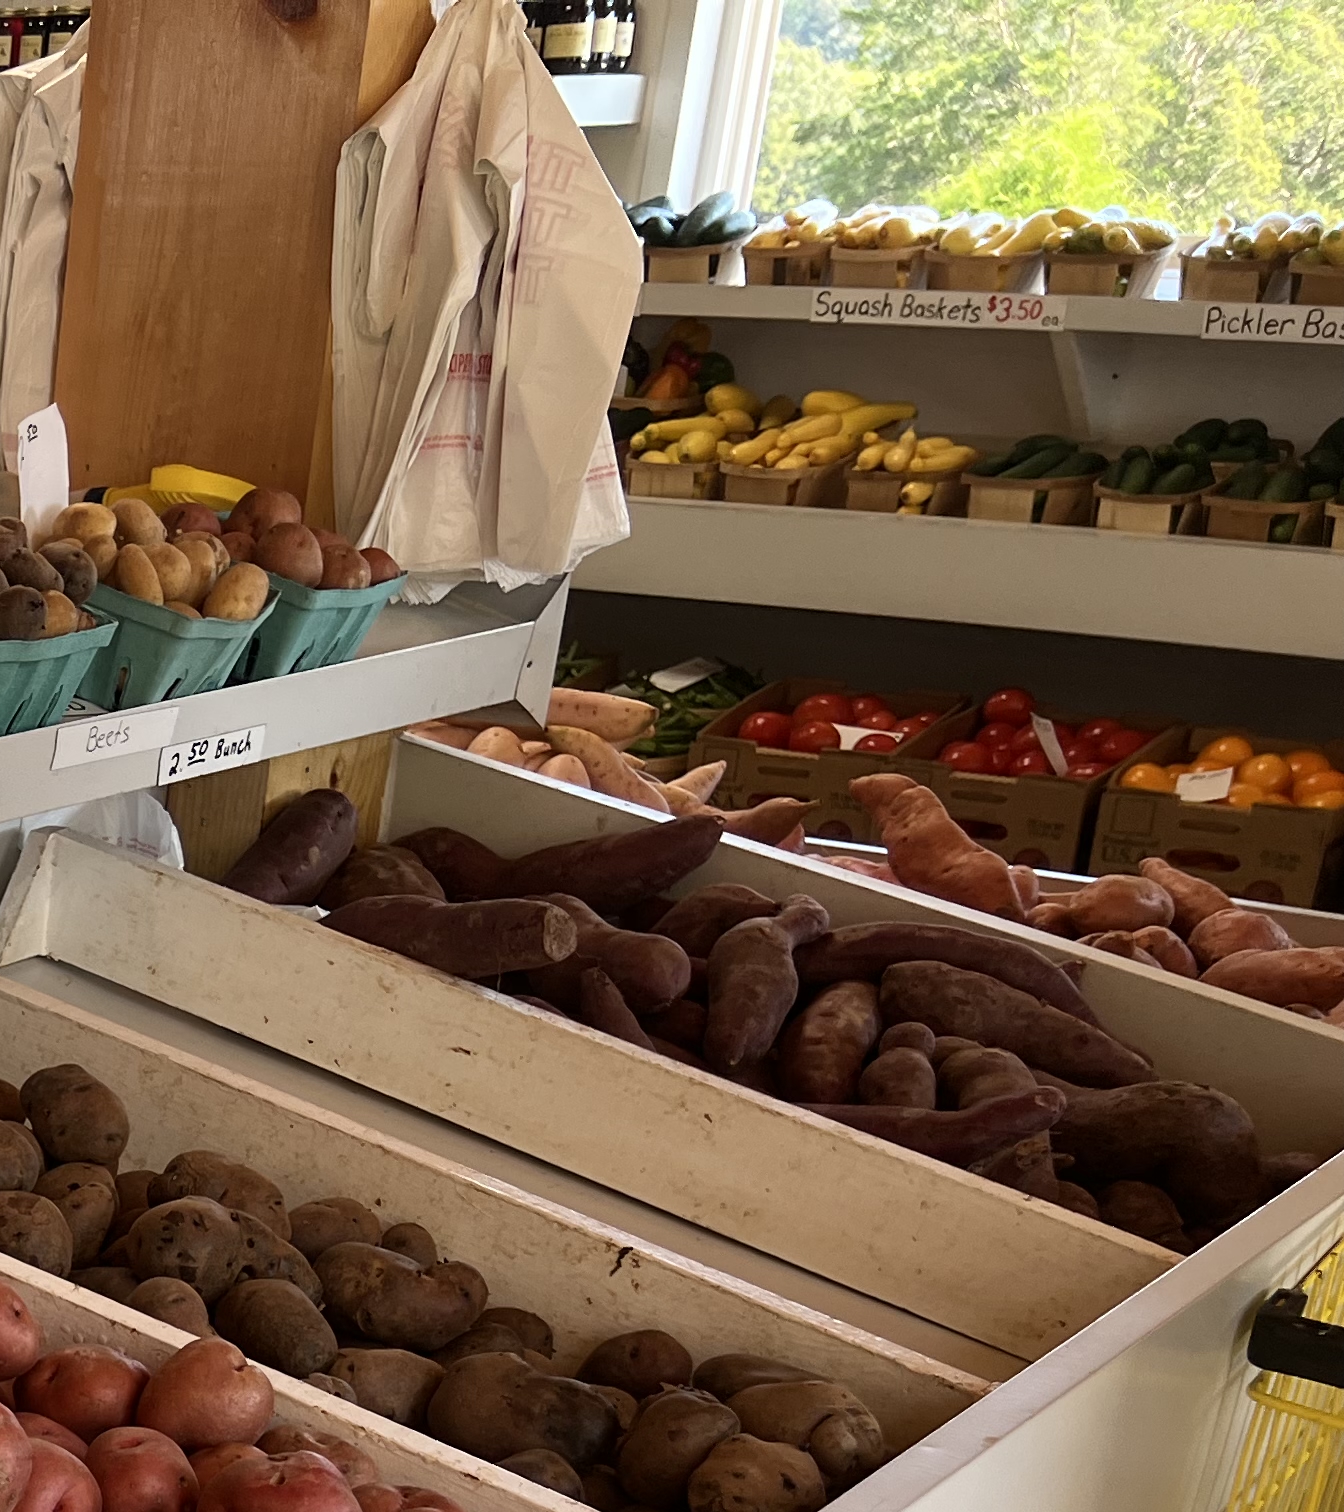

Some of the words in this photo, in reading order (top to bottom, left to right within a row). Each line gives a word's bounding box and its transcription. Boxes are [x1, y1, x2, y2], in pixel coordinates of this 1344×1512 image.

[815, 290, 892, 325] Squash
[899, 293, 982, 324] Baskets
[987, 295, 1043, 322] $3.50
[1205, 306, 1295, 336] Pickler
[85, 719, 130, 753] Beets
[214, 730, 252, 760] Bunch
